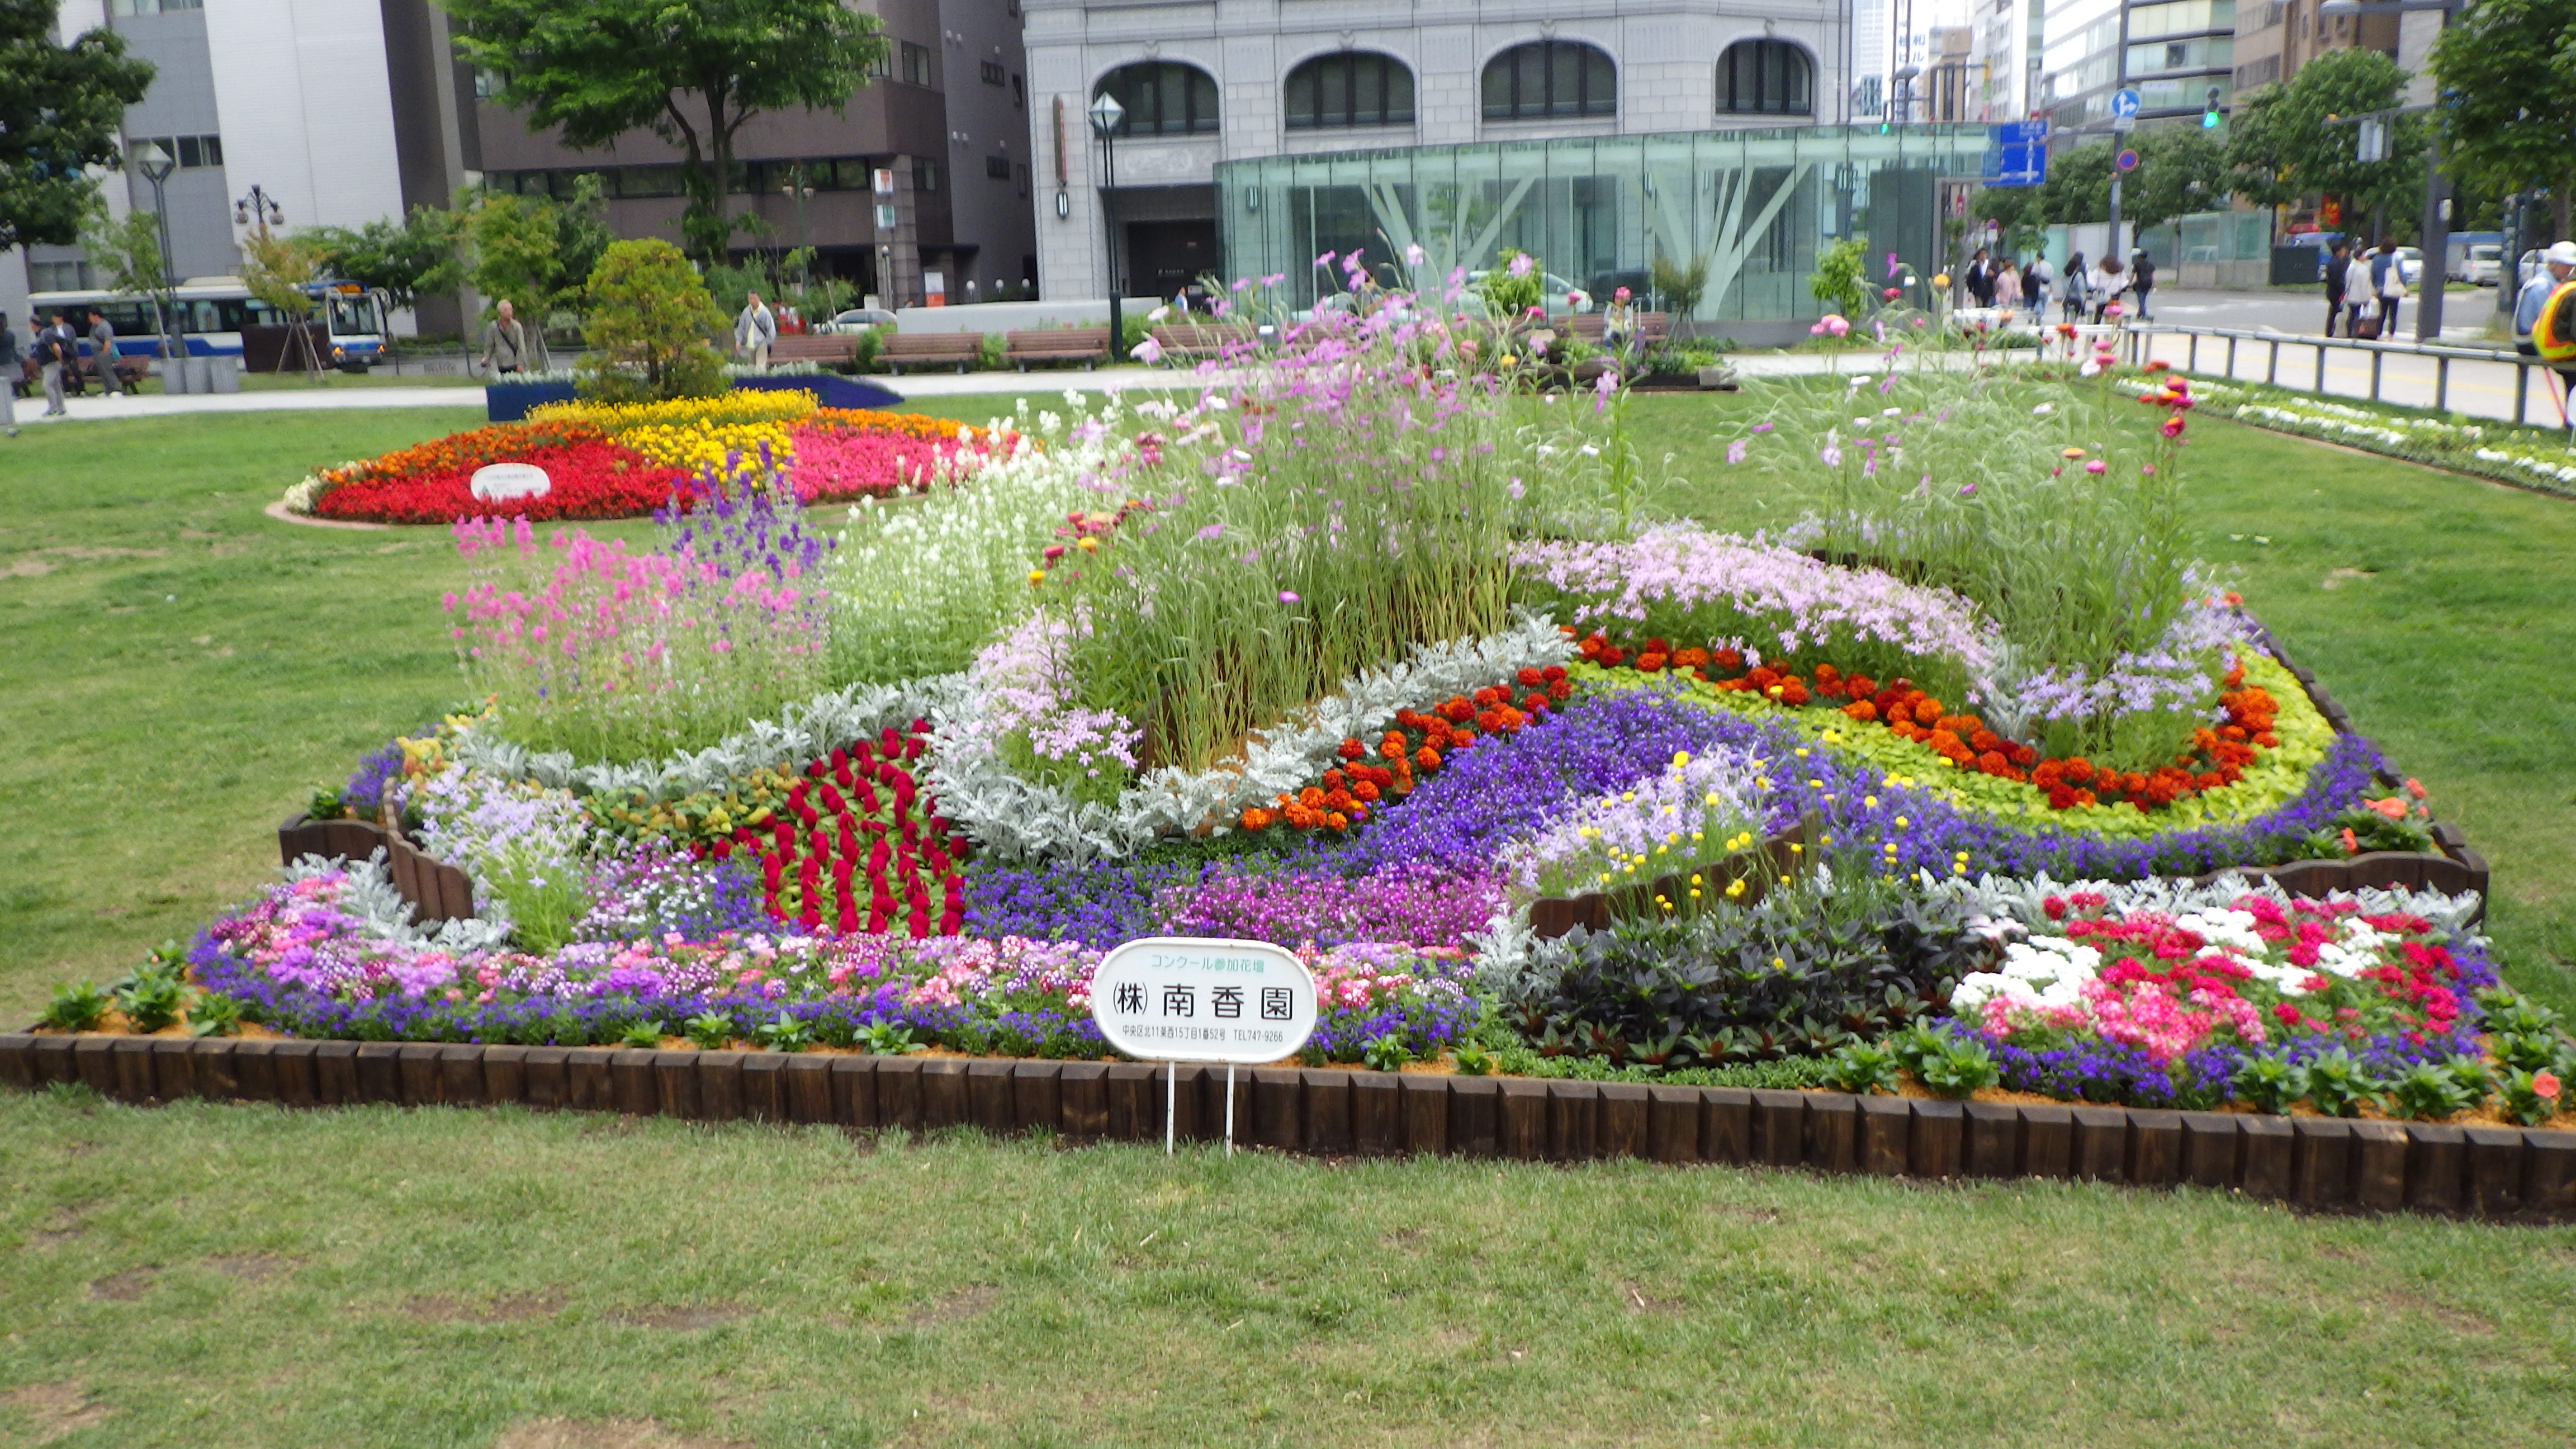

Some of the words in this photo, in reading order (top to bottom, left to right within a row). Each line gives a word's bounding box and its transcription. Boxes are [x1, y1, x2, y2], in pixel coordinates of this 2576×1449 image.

[1152, 954, 1264, 973] コンクール参加花壇
